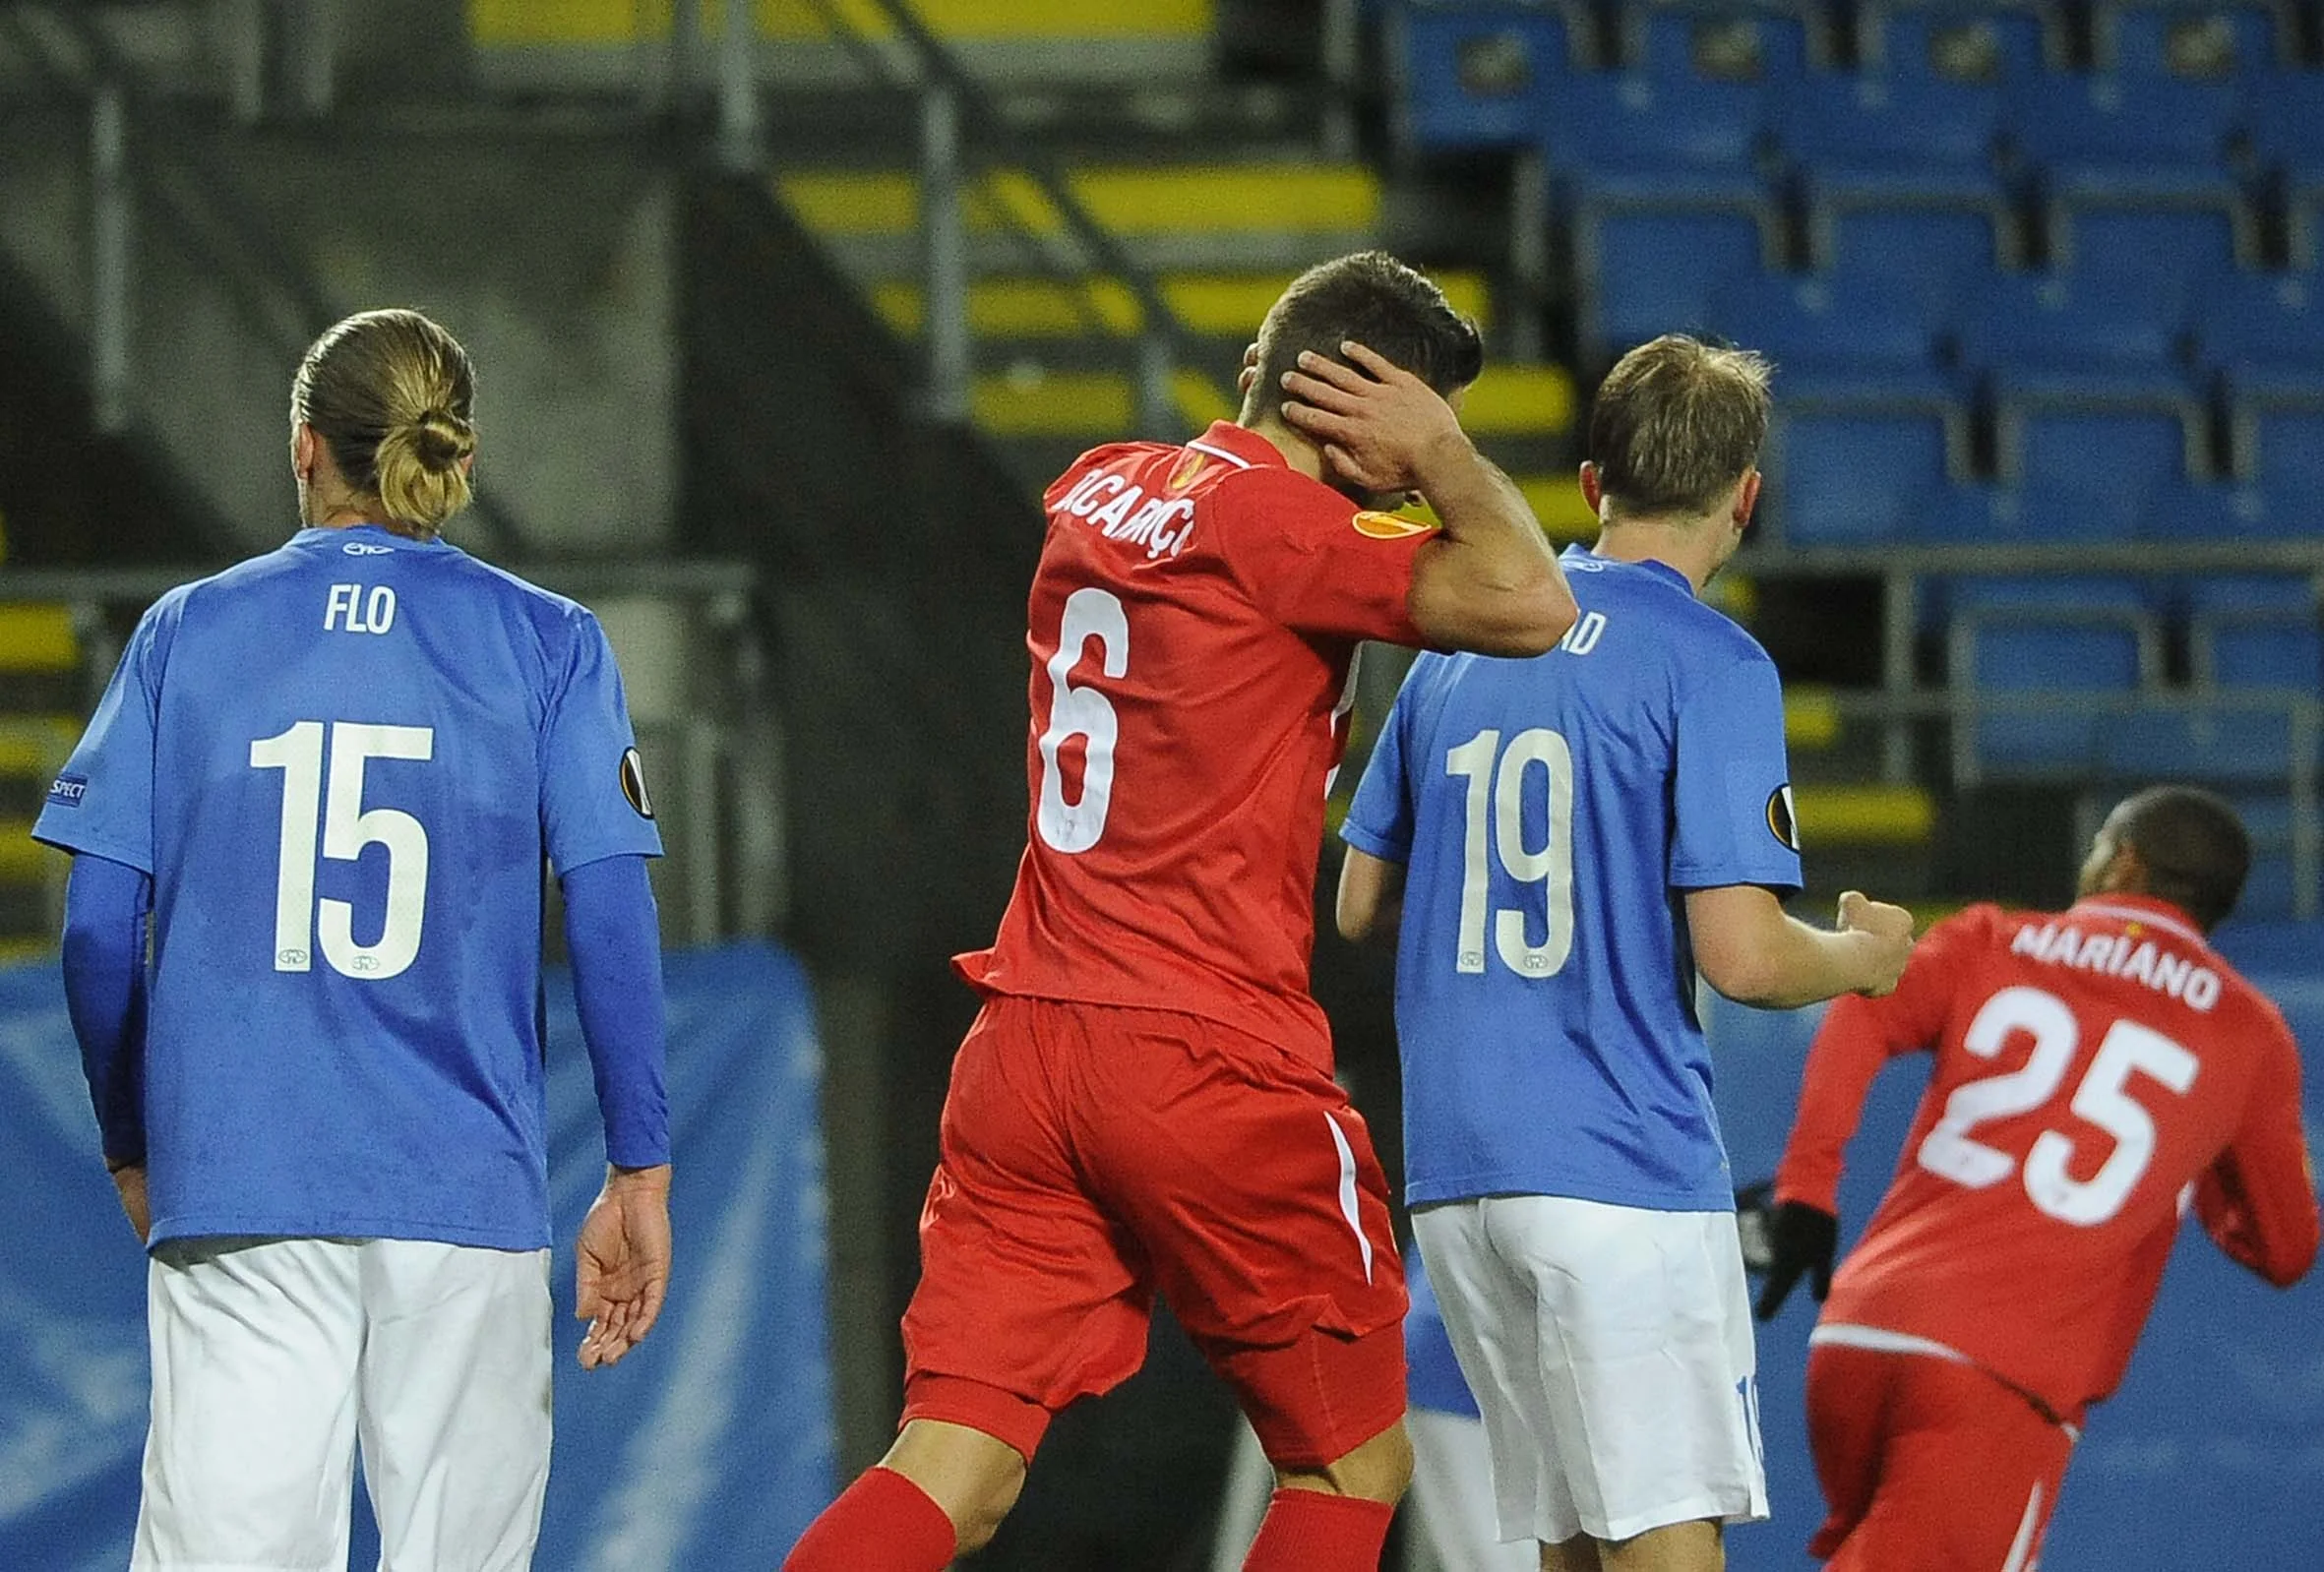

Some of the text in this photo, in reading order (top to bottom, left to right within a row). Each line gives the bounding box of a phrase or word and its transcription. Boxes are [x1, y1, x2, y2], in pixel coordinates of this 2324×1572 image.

[323, 583, 397, 635] FLO
[1037, 587, 1130, 854] 6
[249, 720, 434, 981] 15
[1445, 727, 1573, 979] 19
[2010, 923, 2223, 1012] MARIANO
[1917, 985, 2201, 1228] 25
